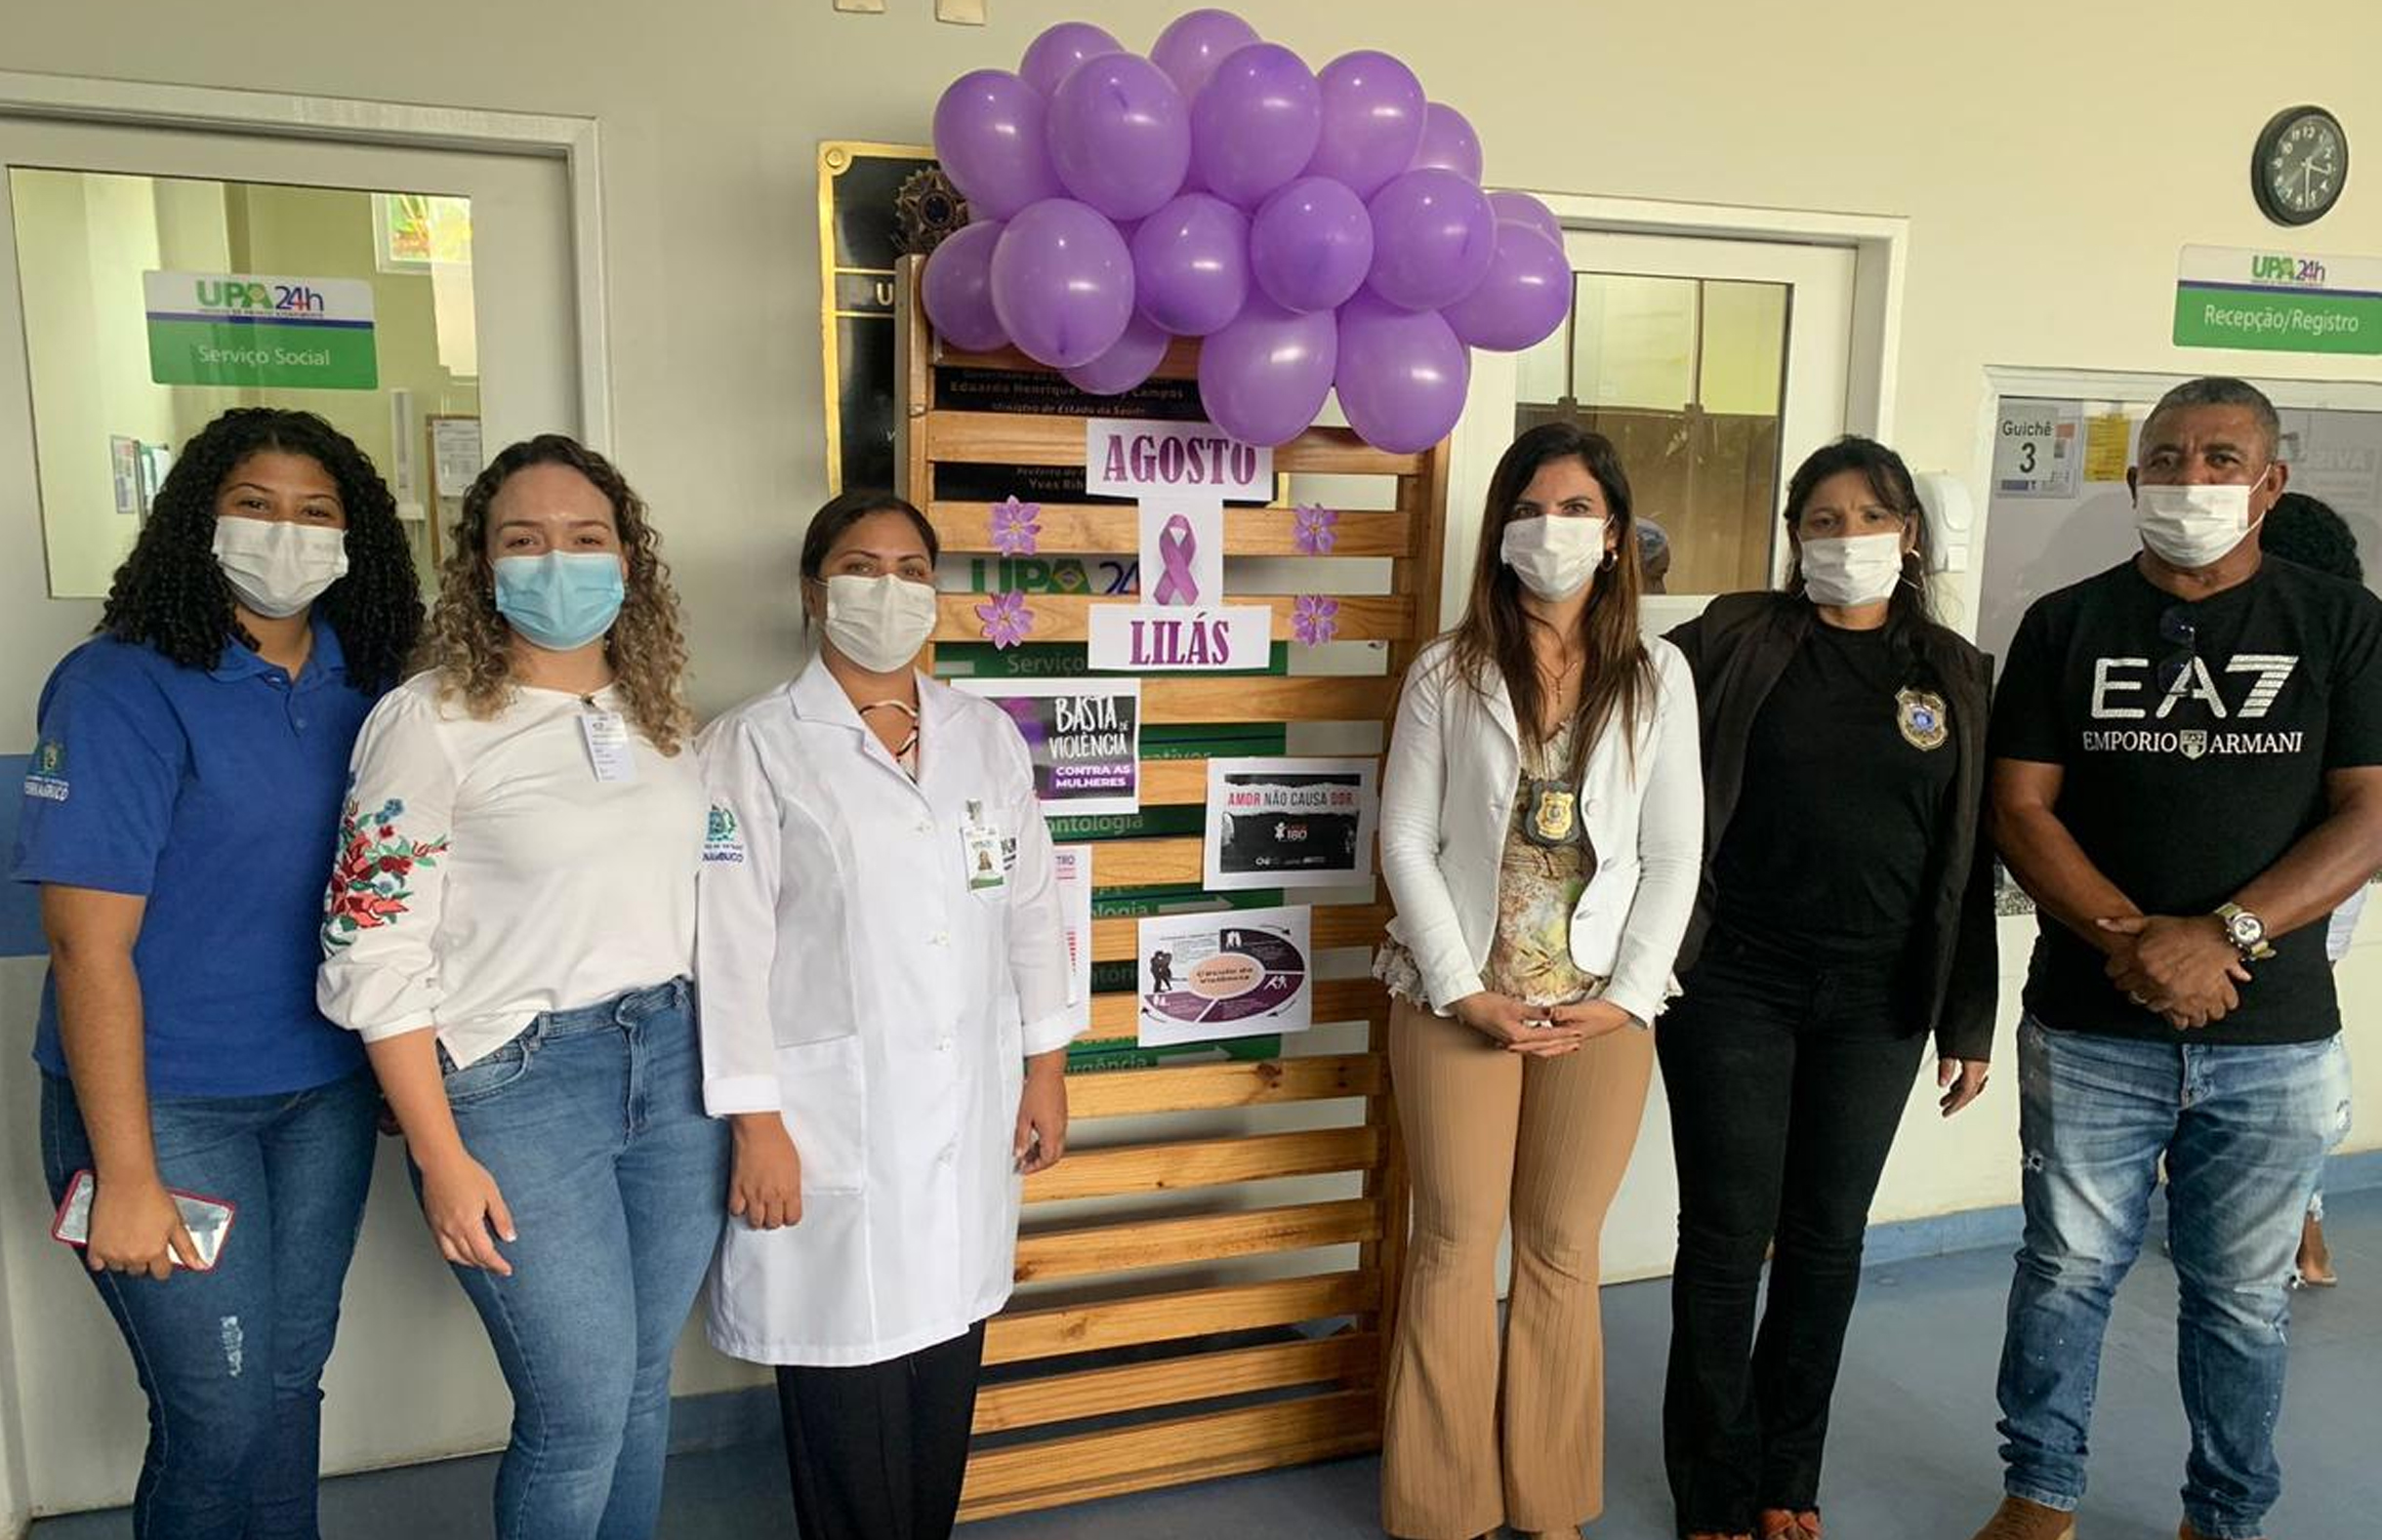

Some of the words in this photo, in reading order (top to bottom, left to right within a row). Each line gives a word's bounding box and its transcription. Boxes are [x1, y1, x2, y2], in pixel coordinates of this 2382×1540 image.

[2252, 255, 2293, 280] UPA
[2295, 260, 2325, 282] 24h
[196, 280, 274, 308] UPA
[274, 285, 324, 311] 24h
[2204, 304, 2359, 336] Recepção/Registro
[198, 344, 268, 367] Serviço
[274, 347, 330, 366] Social
[2002, 420, 2052, 436] Guichê
[1103, 434, 1256, 485] AGOSTO
[2020, 442, 2036, 473] 3
[1129, 611, 1230, 666] LILÁS
[2091, 654, 2299, 719] EA7
[1055, 695, 1118, 732] BASTA
[1048, 732, 1129, 759] VIOLÊNCIA
[2082, 731, 2178, 752] EMPORIO
[2209, 731, 2304, 754] ARMANI
[1055, 766, 1111, 777] CONTRA
[1113, 765, 1131, 775] AS
[1055, 777, 1127, 789] MULHERES
[1228, 791, 1261, 806] AMOR
[1264, 790, 1288, 806] NÃO
[1291, 791, 1328, 806] CAUSA
